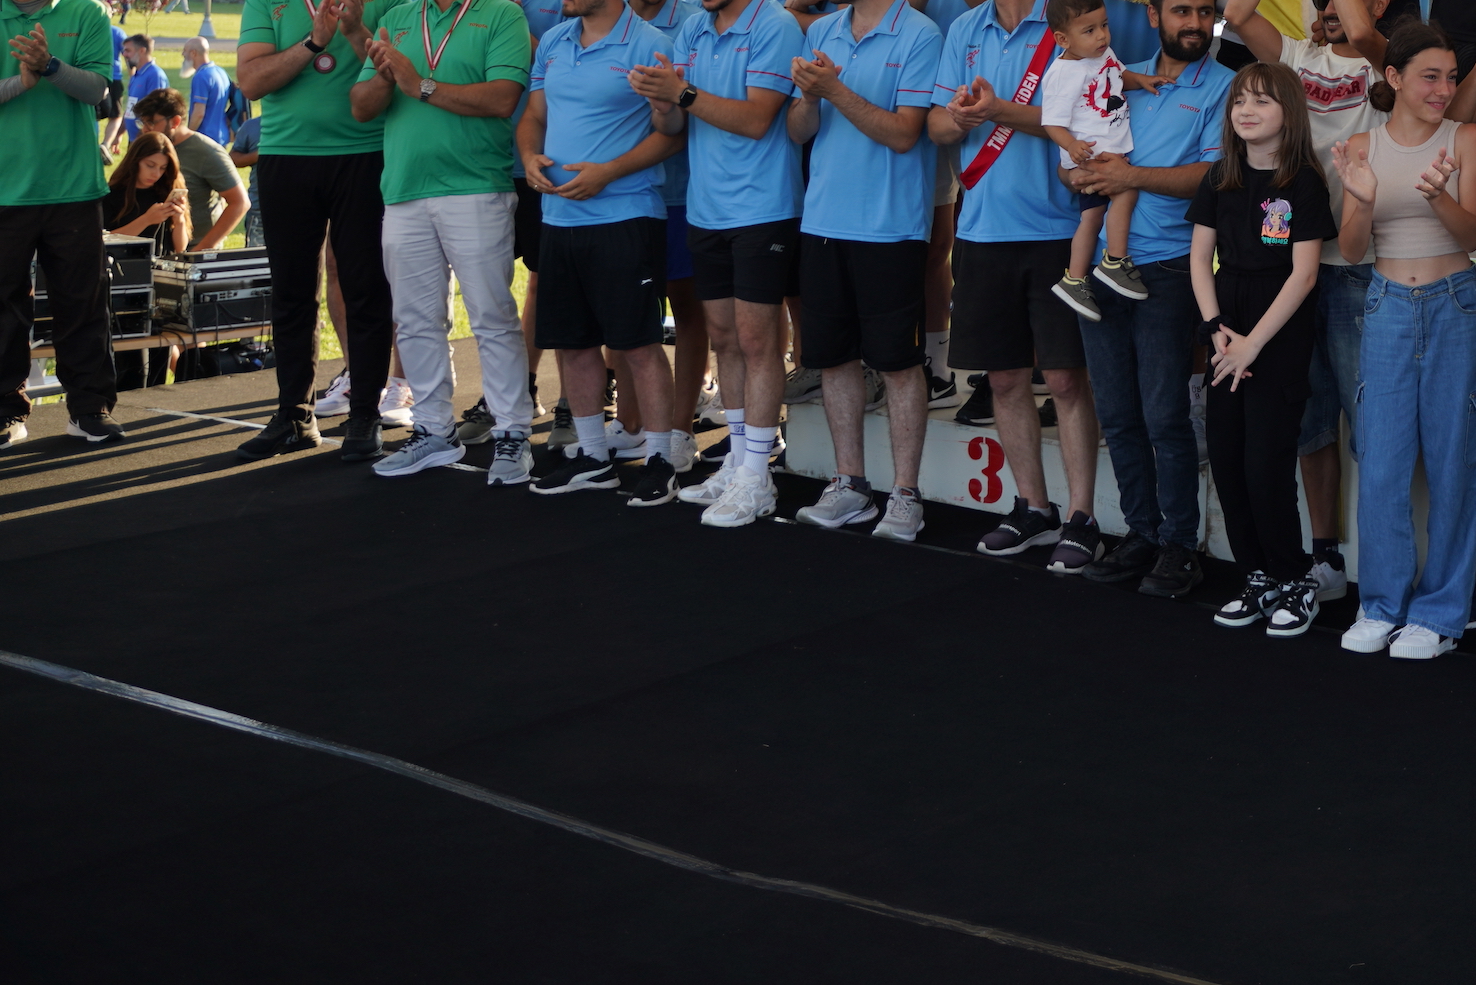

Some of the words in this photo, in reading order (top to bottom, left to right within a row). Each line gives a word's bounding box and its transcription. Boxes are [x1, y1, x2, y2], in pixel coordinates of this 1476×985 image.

[538, 7, 559, 15] TOYOTA
[1304, 81, 1331, 103] BAD
[1333, 80, 1361, 98] EAR
[1178, 103, 1201, 113] TOYOTA
[967, 435, 1006, 504] 3
